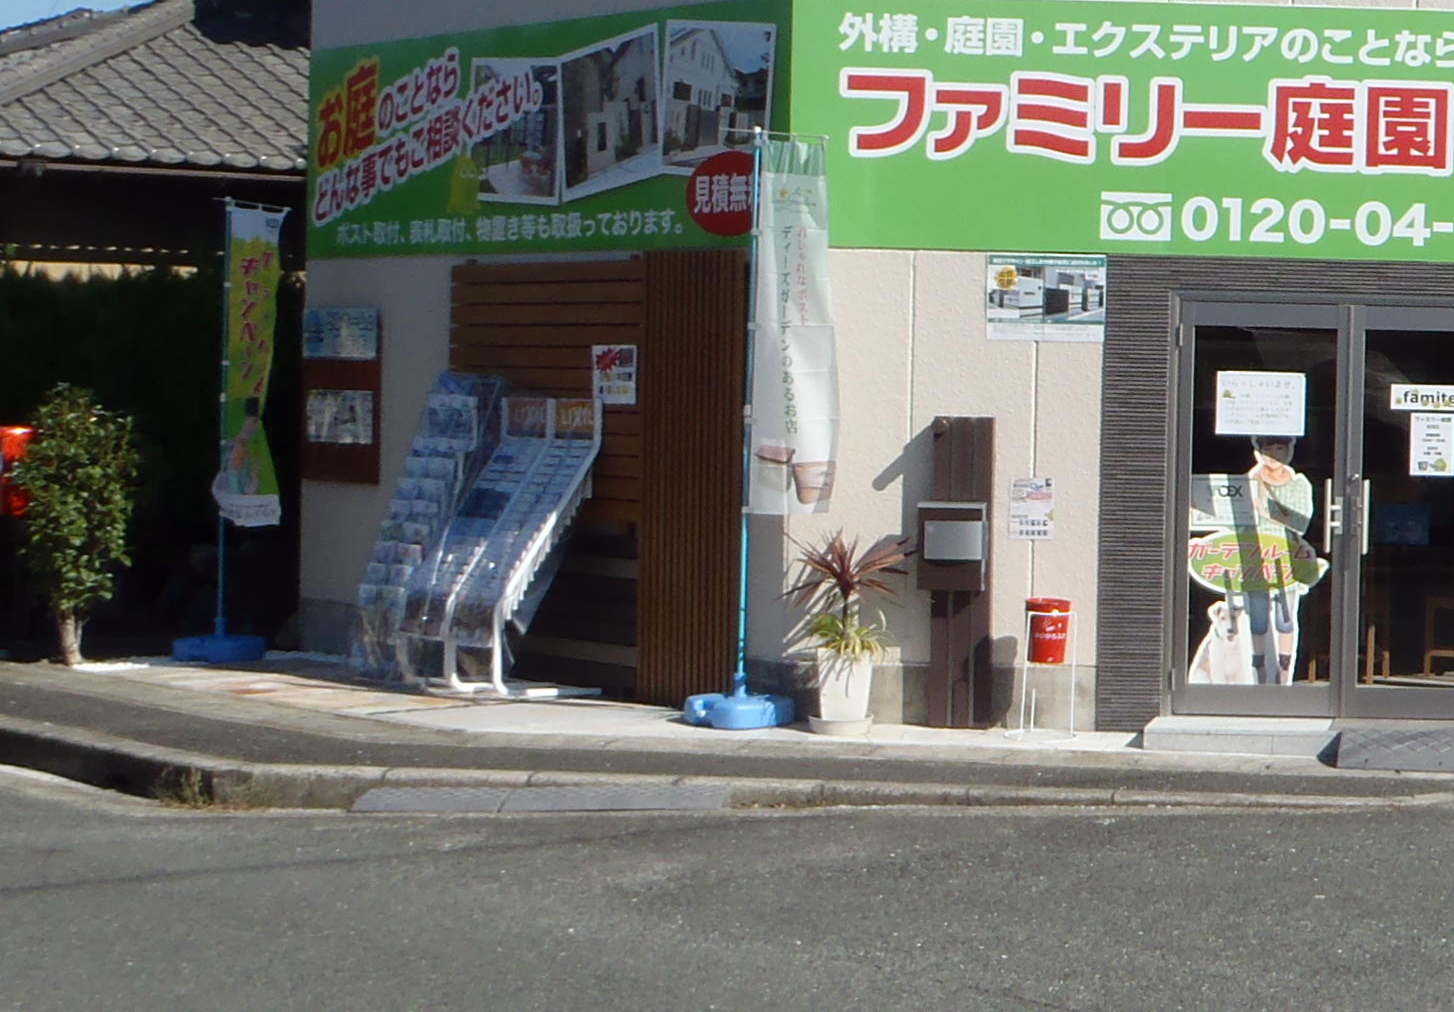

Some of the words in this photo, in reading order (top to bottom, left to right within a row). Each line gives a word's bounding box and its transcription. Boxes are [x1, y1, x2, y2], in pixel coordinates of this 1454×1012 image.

[314, 70, 543, 227] どんな事でもご相談ください。
[316, 48, 460, 168] お庭のことなら
